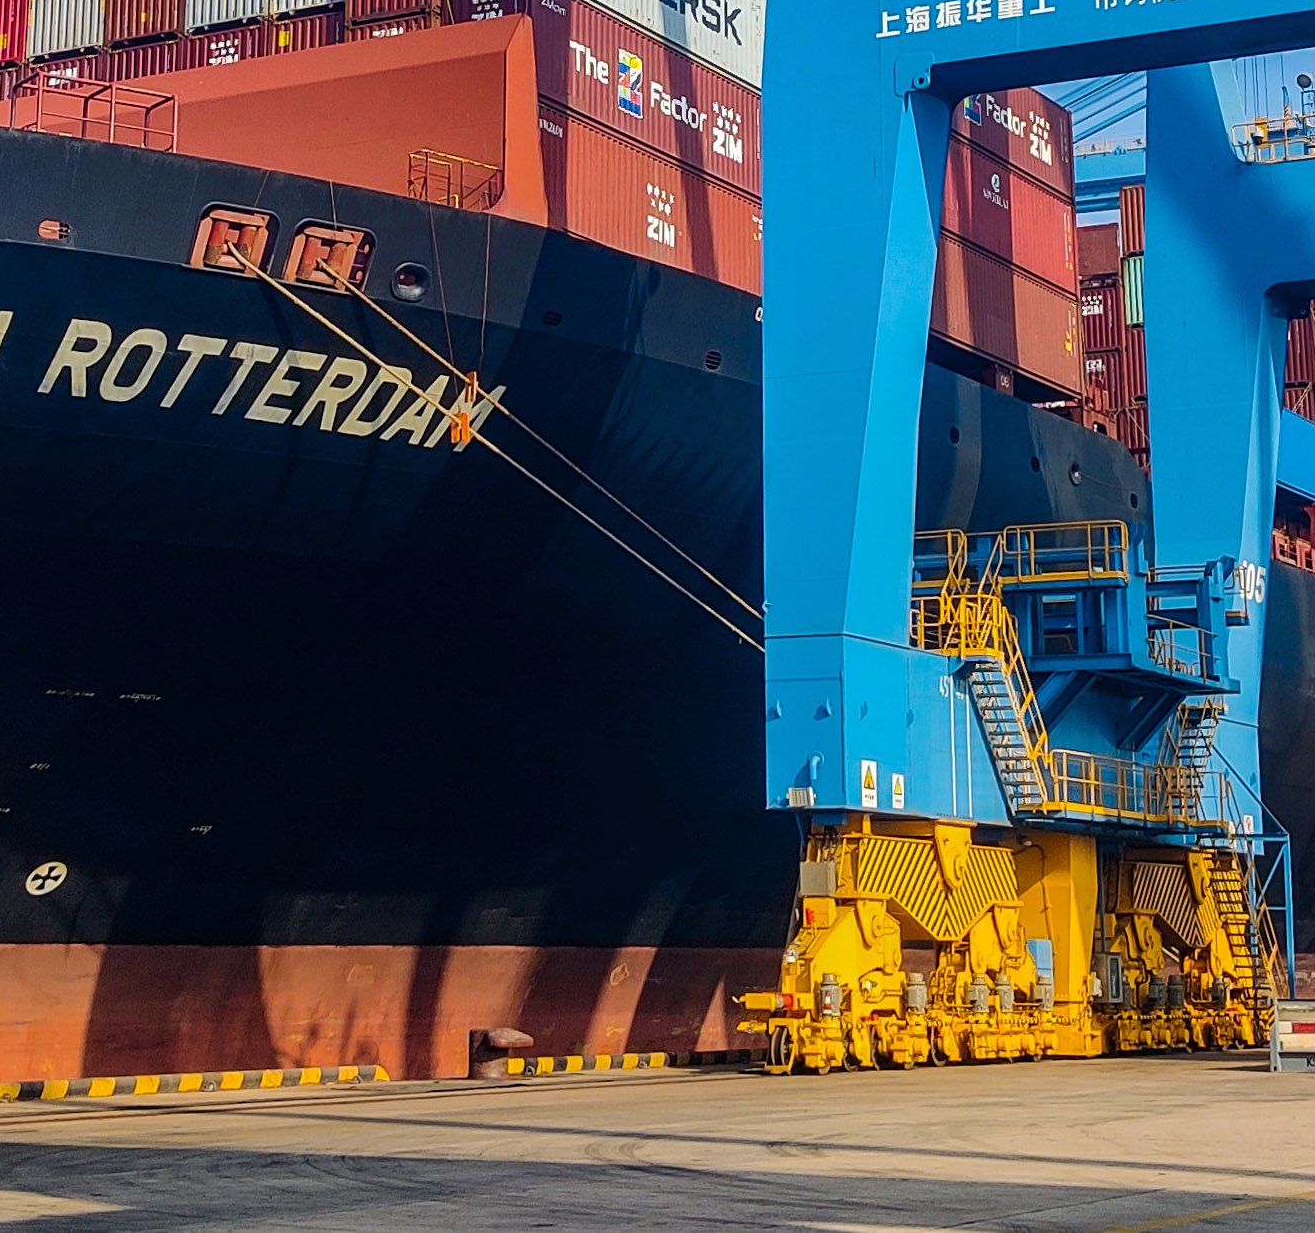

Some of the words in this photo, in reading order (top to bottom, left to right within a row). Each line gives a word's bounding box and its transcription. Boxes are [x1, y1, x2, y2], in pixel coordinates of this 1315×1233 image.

[569, 40, 609, 85] The
[650, 81, 708, 132] Factor
[986, 94, 1026, 138] Factor
[712, 127, 743, 164] ZIM
[1029, 132, 1052, 166] ZIM
[646, 214, 675, 248] ZIM
[37, 318, 507, 453] ROTTERDAM
